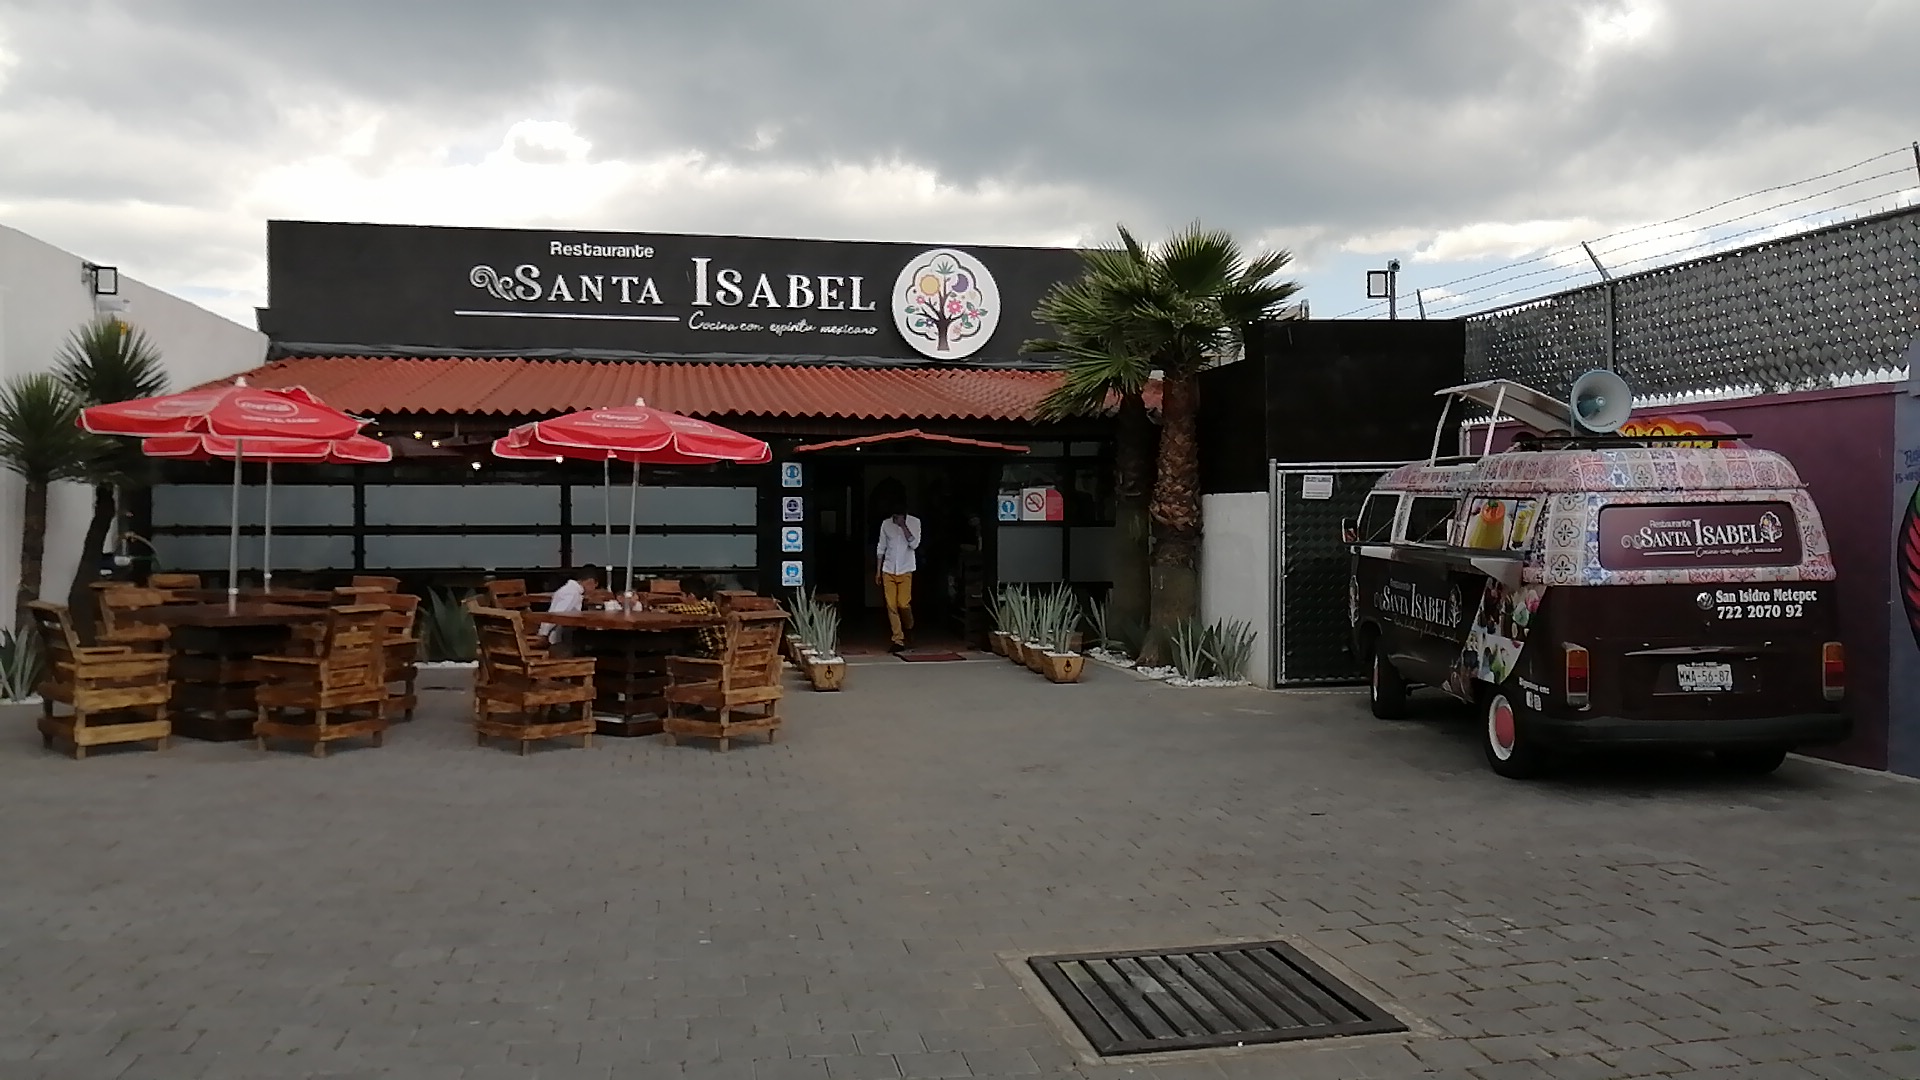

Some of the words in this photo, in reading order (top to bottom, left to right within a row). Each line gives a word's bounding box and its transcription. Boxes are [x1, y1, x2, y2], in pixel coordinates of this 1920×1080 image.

[550, 241, 655, 258] Restaurante
[514, 264, 664, 305] SANTA
[690, 257, 876, 311] ISABEL
[688, 310, 738, 331] Cocina
[739, 323, 764, 332] con
[819, 325, 878, 335] mexicano
[1640, 526, 1692, 548] SANTA
[1692, 518, 1764, 547] ISABEL
[1411, 583, 1450, 627] ISABEL
[1716, 589, 1737, 603] San
[1738, 588, 1771, 603] Isidro
[1773, 588, 1818, 605] Metepec
[1717, 605, 1743, 619] 722
[1747, 604, 1782, 618] 2070
[1785, 604, 1803, 617] 92
